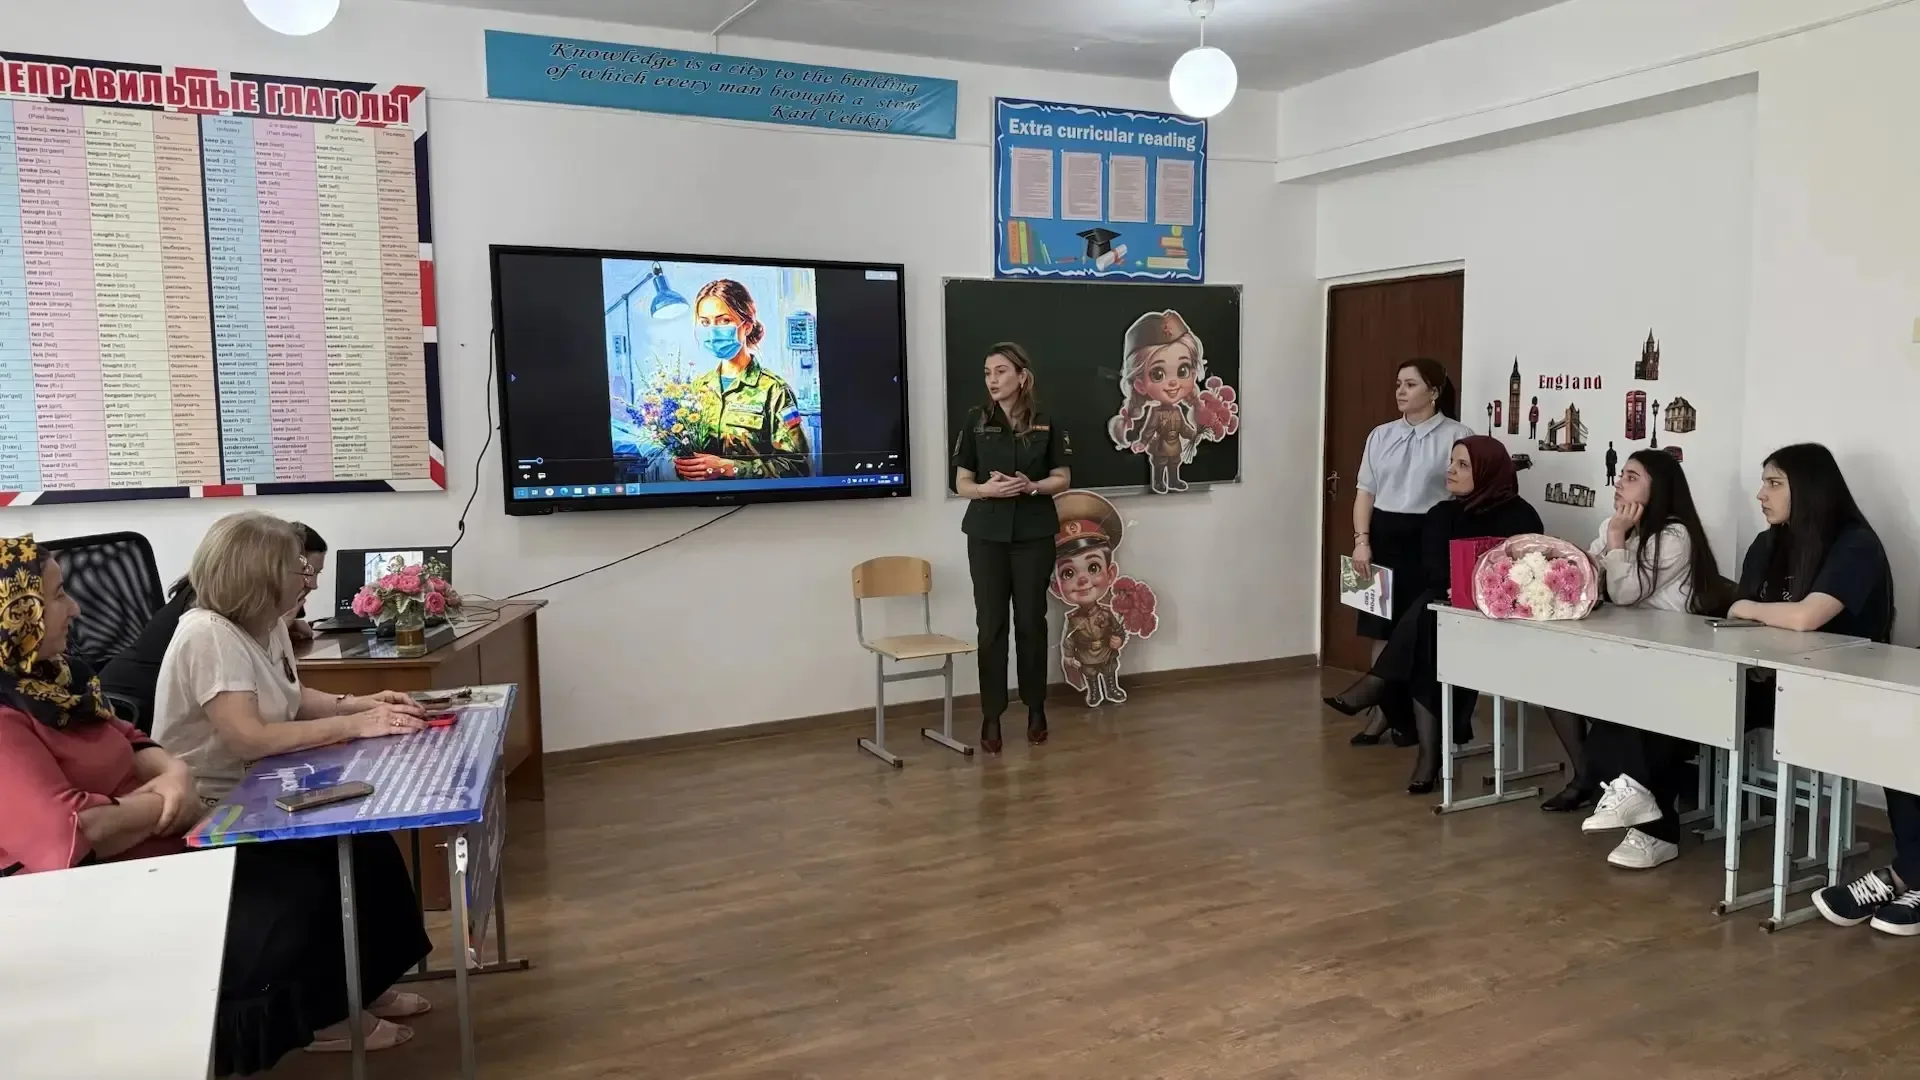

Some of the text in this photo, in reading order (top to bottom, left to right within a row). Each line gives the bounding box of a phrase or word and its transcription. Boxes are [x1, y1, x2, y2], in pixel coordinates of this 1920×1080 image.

[546, 64, 921, 111] of which every man brought a stone
[551, 43, 918, 96] Knowledge is a city to the building
[265, 81, 410, 123] ГЛАГОЛЫ
[770, 104, 892, 131] Karl Velikiy
[1009, 118, 1196, 151] Extra curricular reading
[1539, 373, 1602, 390] England
